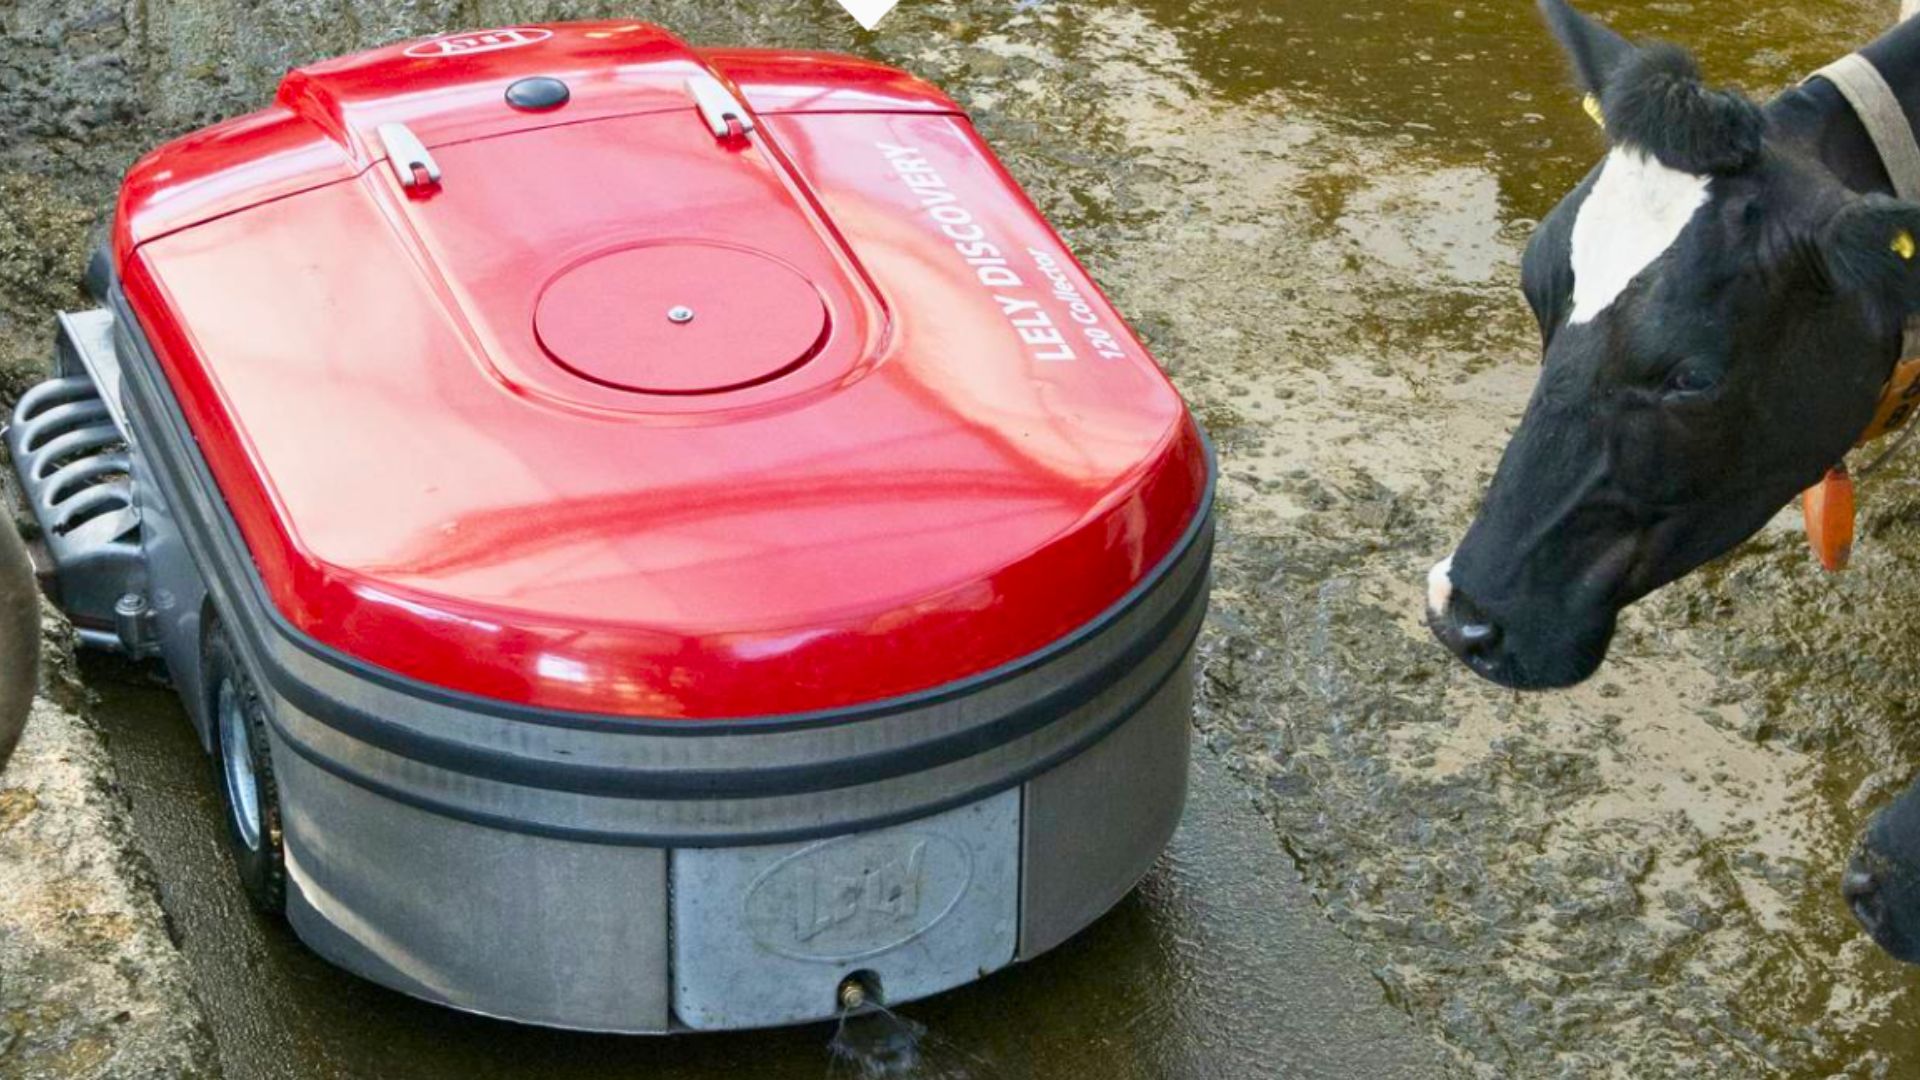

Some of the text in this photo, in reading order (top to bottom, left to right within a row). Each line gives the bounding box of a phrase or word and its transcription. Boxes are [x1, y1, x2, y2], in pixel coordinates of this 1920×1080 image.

[875, 141, 1077, 361] LELY DISCOVERY
[1027, 246, 1126, 360] 120 Collector
